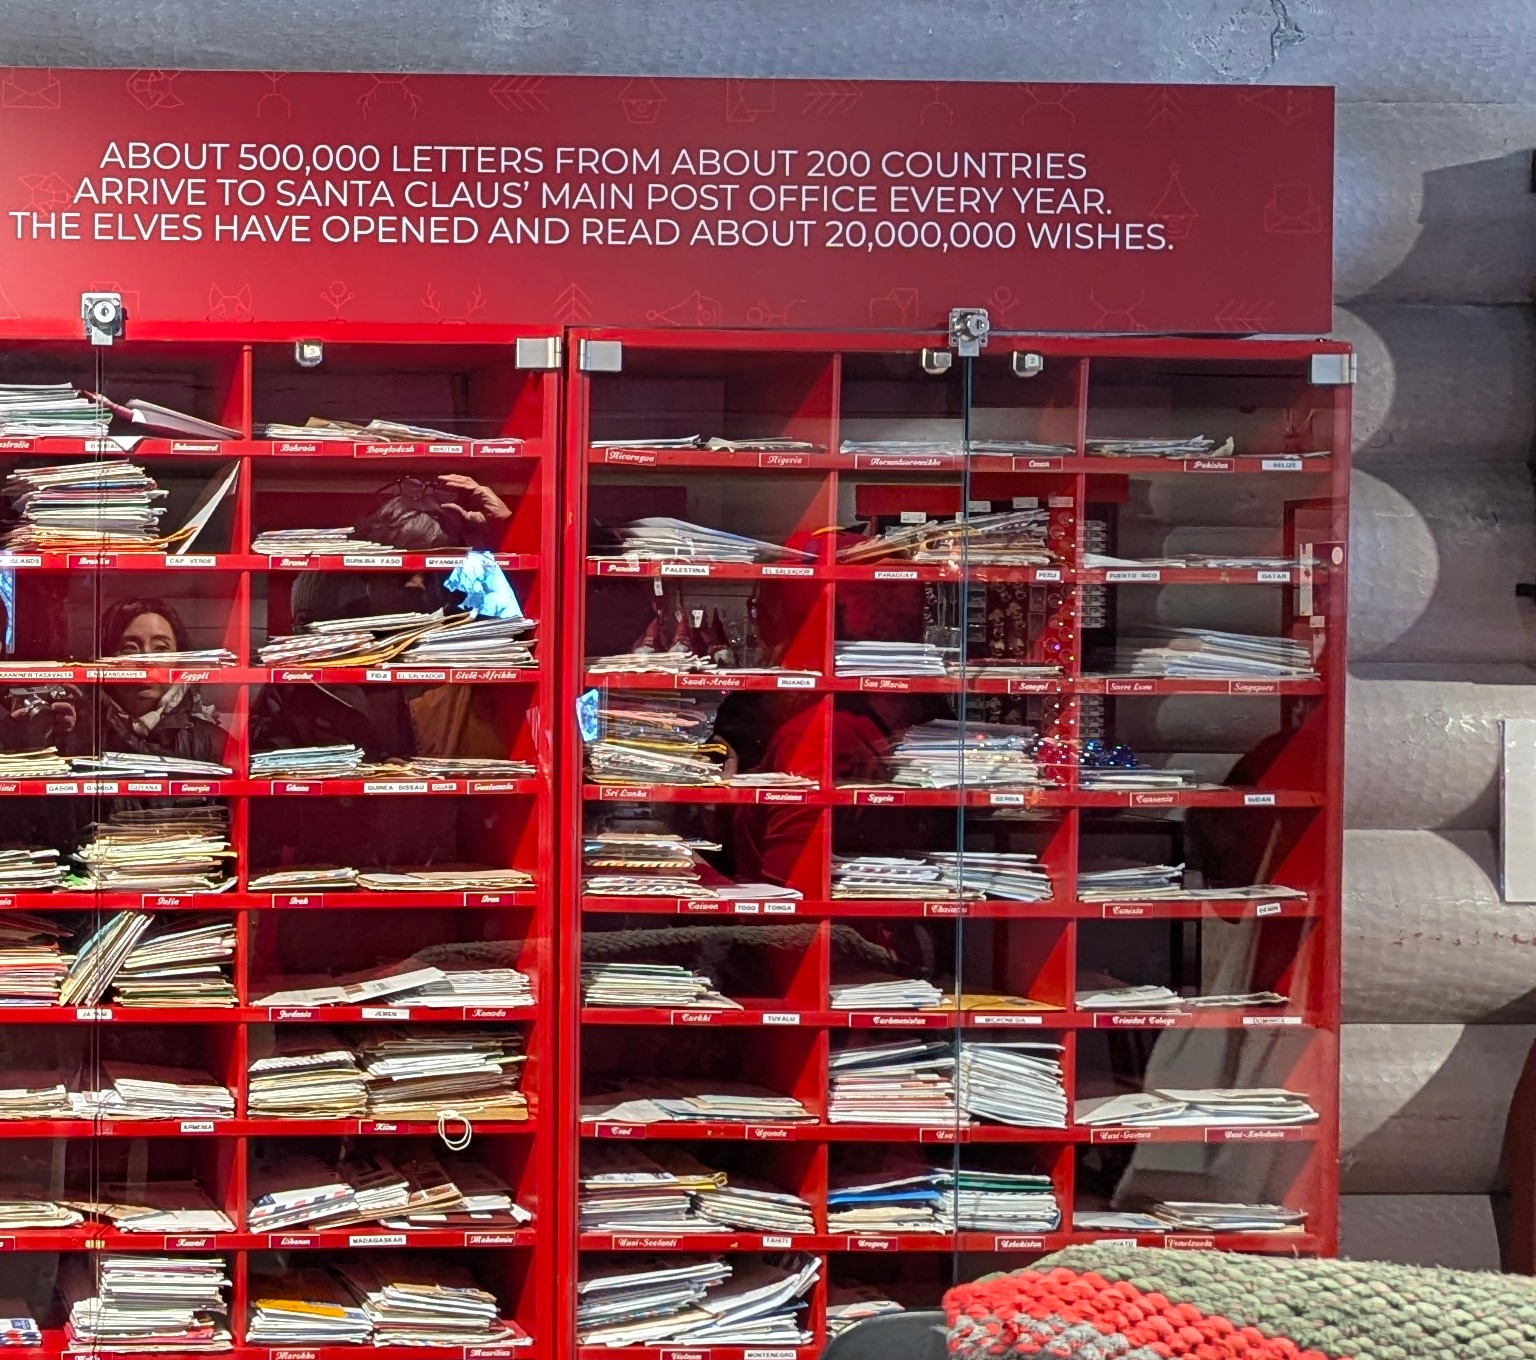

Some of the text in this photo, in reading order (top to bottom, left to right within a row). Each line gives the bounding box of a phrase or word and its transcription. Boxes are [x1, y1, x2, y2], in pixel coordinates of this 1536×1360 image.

[100, 141, 1087, 181] ABOUT 500,000 LETTERS FROM ABOUT 200 COUNTRIES
[72, 176, 207, 207] ARRIVE
[217, 178, 266, 207] TO
[275, 180, 395, 209] SANTA
[541, 183, 634, 211] MAIN
[646, 183, 740, 212] POST
[749, 185, 878, 214] OFFICE
[890, 186, 1005, 215] EVERY
[1011, 187, 1113, 216] YEAR.
[9, 210, 1175, 254] THE ELVES HAVE OPENED AND READ ABOUT 20,000,000 WISHES.
[280, 443, 316, 453] Bahrain
[365, 443, 415, 455] Bangladesh
[479, 445, 516, 455] Bermuda
[608, 451, 655, 464] Nicaragua
[767, 455, 803, 467] Nigeria
[1261, 572, 1287, 580] QATAR
[681, 675, 740, 687] Saudi-Arabia
[781, 679, 811, 687] RUANDA
[1018, 682, 1049, 693] Senegal
[1233, 682, 1275, 694] Singapore
